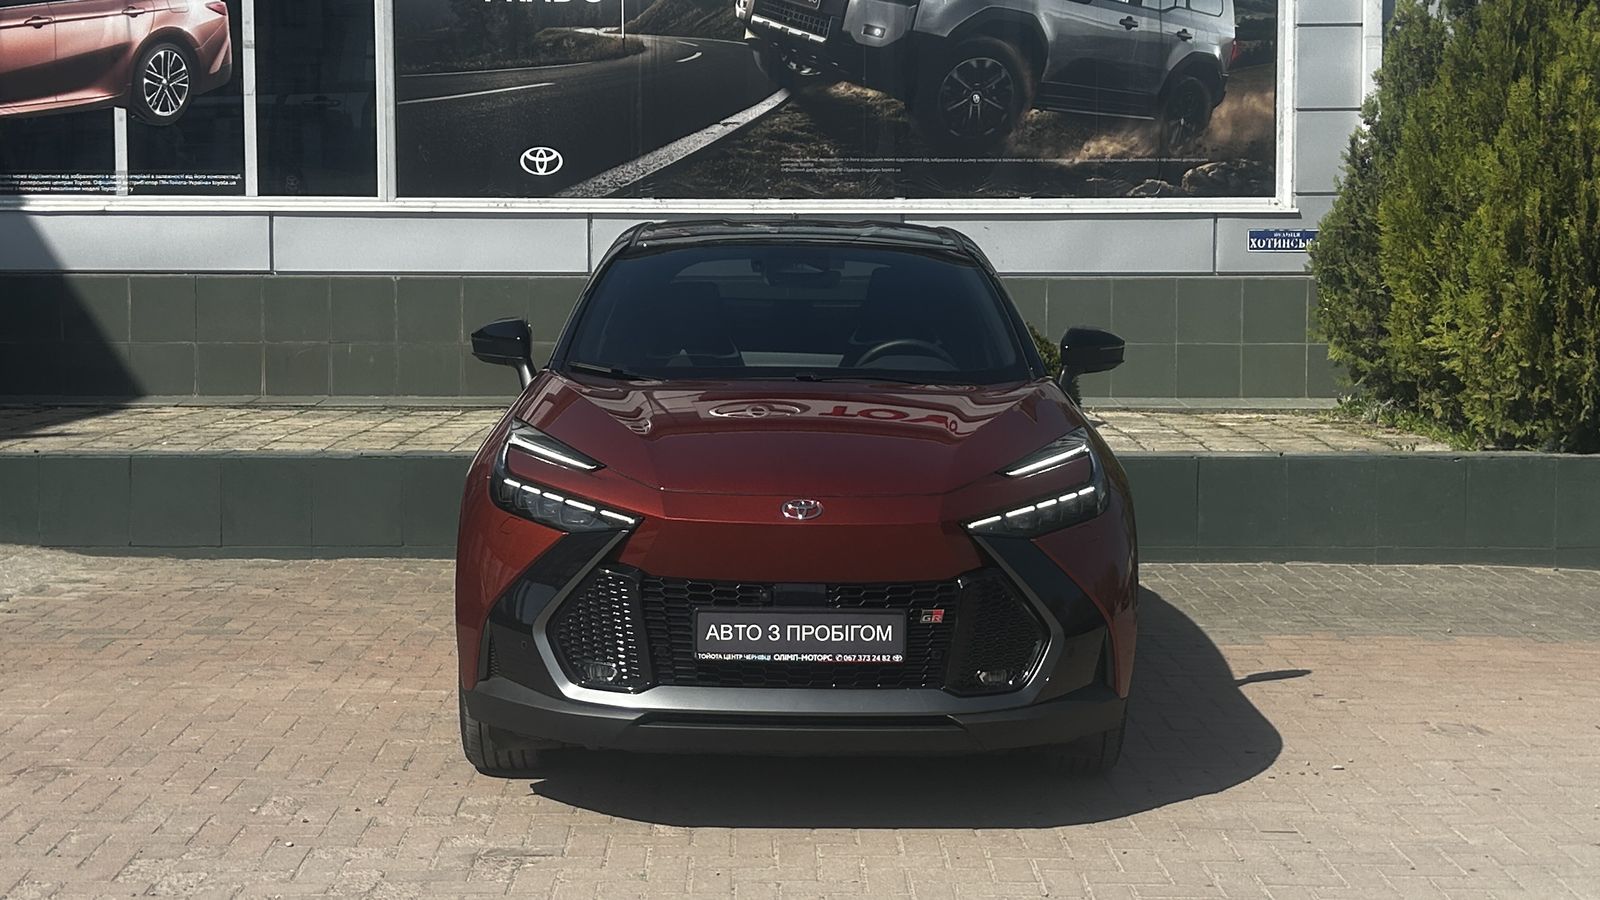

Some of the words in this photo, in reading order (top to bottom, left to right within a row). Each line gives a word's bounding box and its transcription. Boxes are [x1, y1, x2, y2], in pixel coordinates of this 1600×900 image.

[921, 614, 942, 623] GR
[705, 624, 762, 641] АВТО
[787, 624, 892, 641] ПРОБІГОМ
